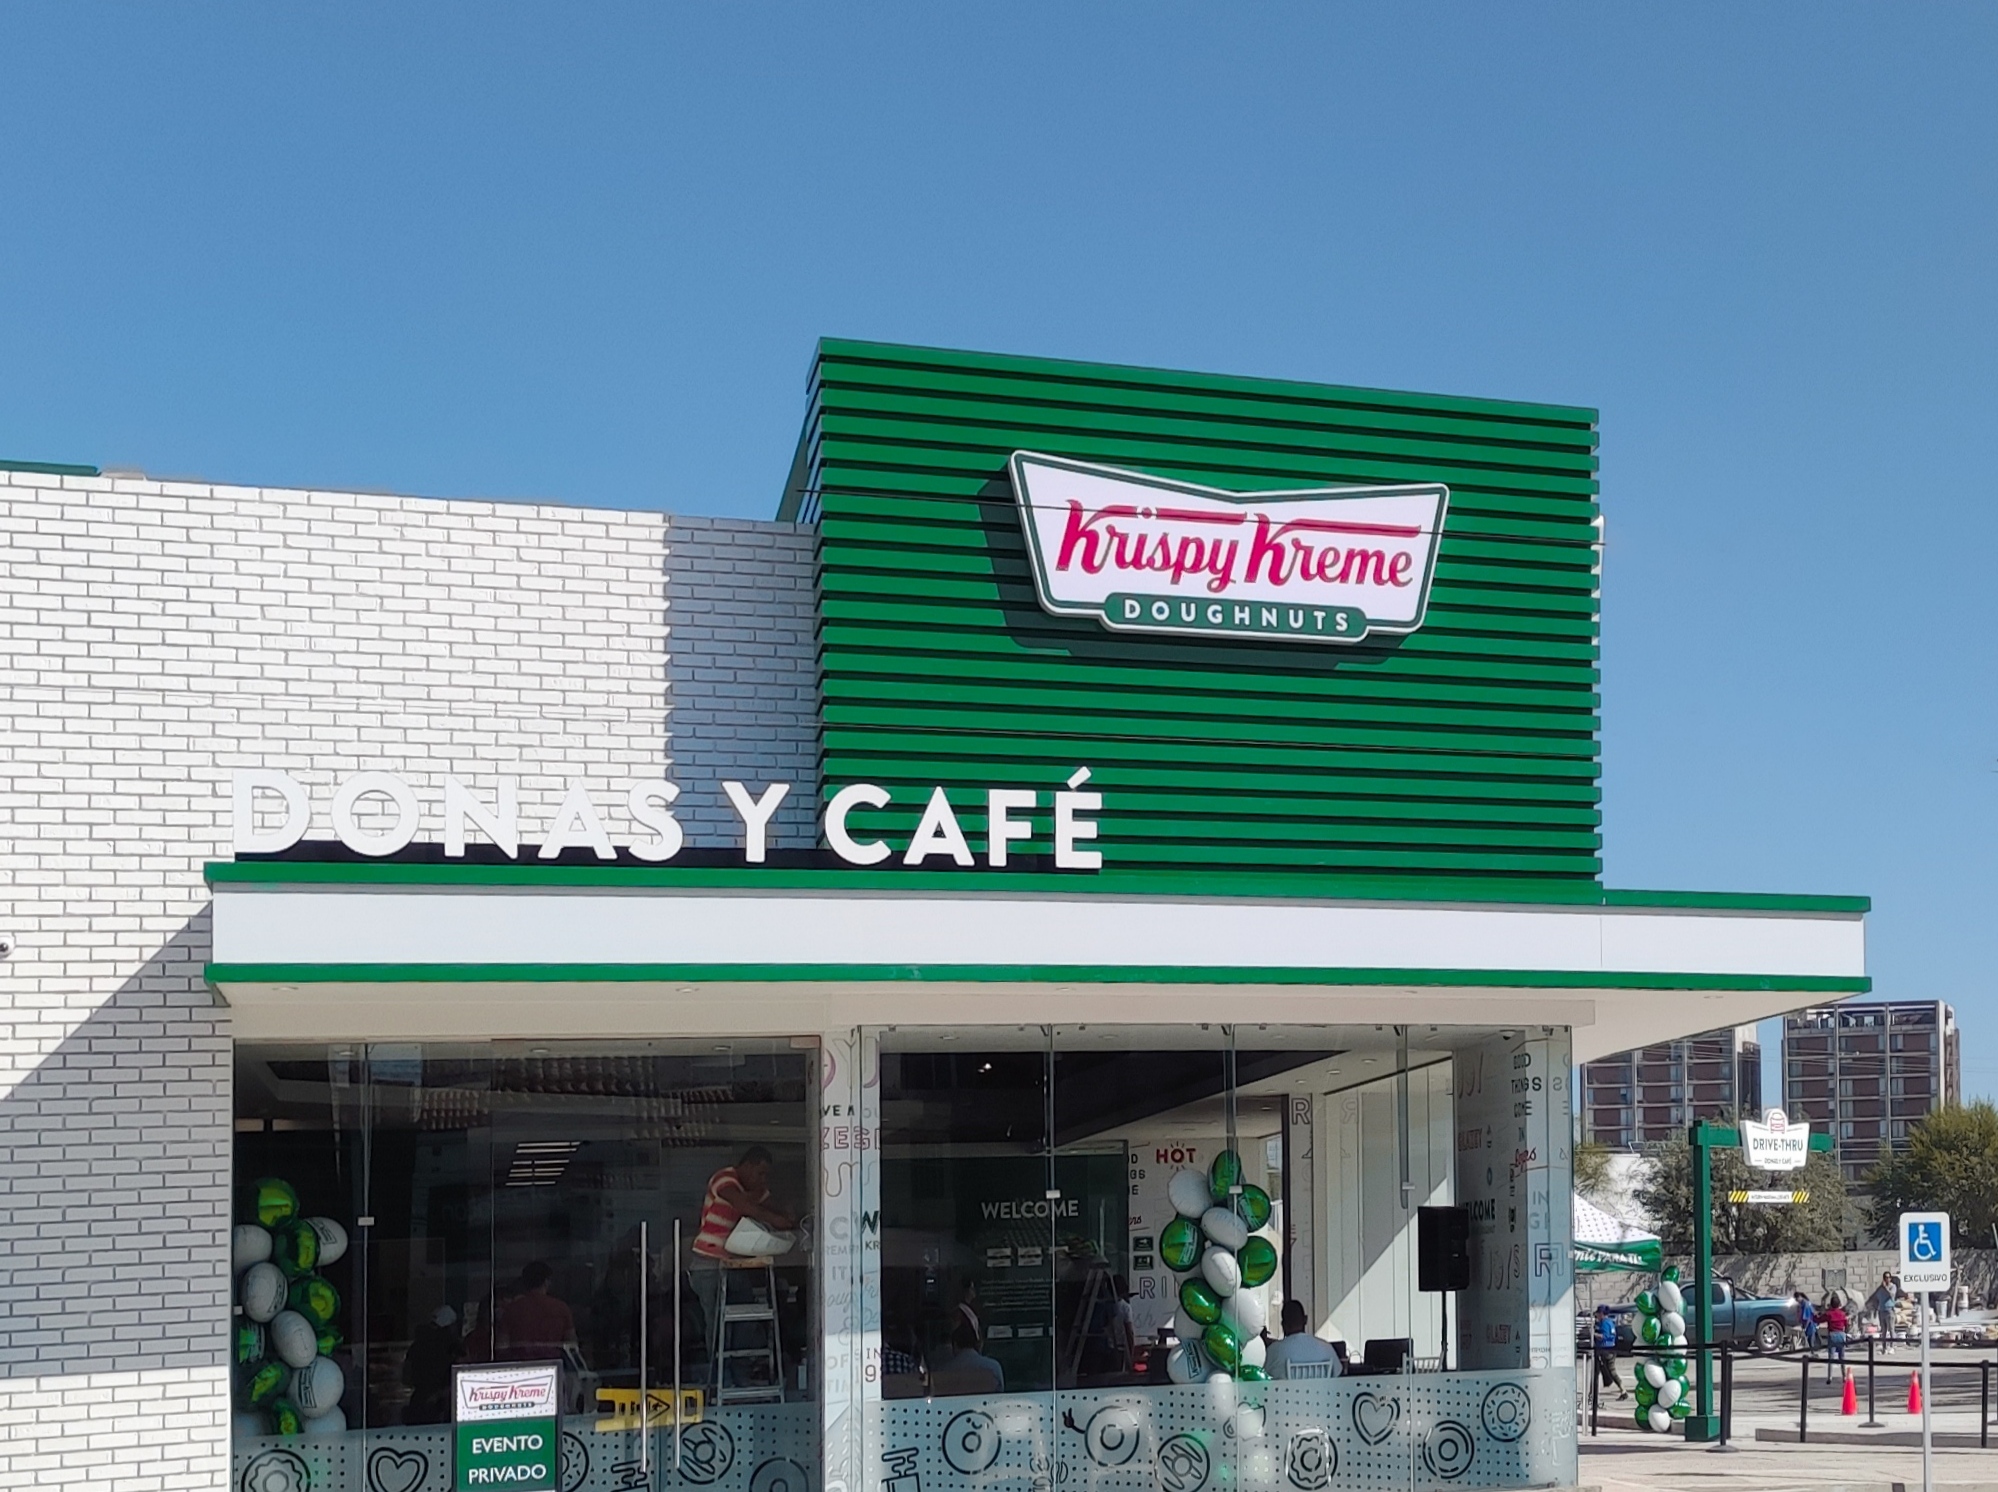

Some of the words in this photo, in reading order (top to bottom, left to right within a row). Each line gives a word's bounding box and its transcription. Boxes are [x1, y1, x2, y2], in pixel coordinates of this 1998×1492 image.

[1056, 499, 1248, 592] Krispy
[1244, 512, 1421, 587] Kreme
[1124, 598, 1349, 632] DOUGHNUTS
[233, 769, 684, 862] DONAS
[721, 781, 791, 863] Y
[825, 766, 1105, 870] CAFÉ
[1752, 1137, 1804, 1151] DRIVE-THRU
[1155, 1147, 1196, 1164] HOT
[981, 1199, 1079, 1220] WELCOME
[1903, 1273, 1948, 1283] EXCLUSIVO
[469, 1386, 509, 1402] Krispy
[508, 1383, 548, 1400] Kreme
[472, 1434, 543, 1455] EVENTO
[468, 1463, 547, 1485] PRIVADO
